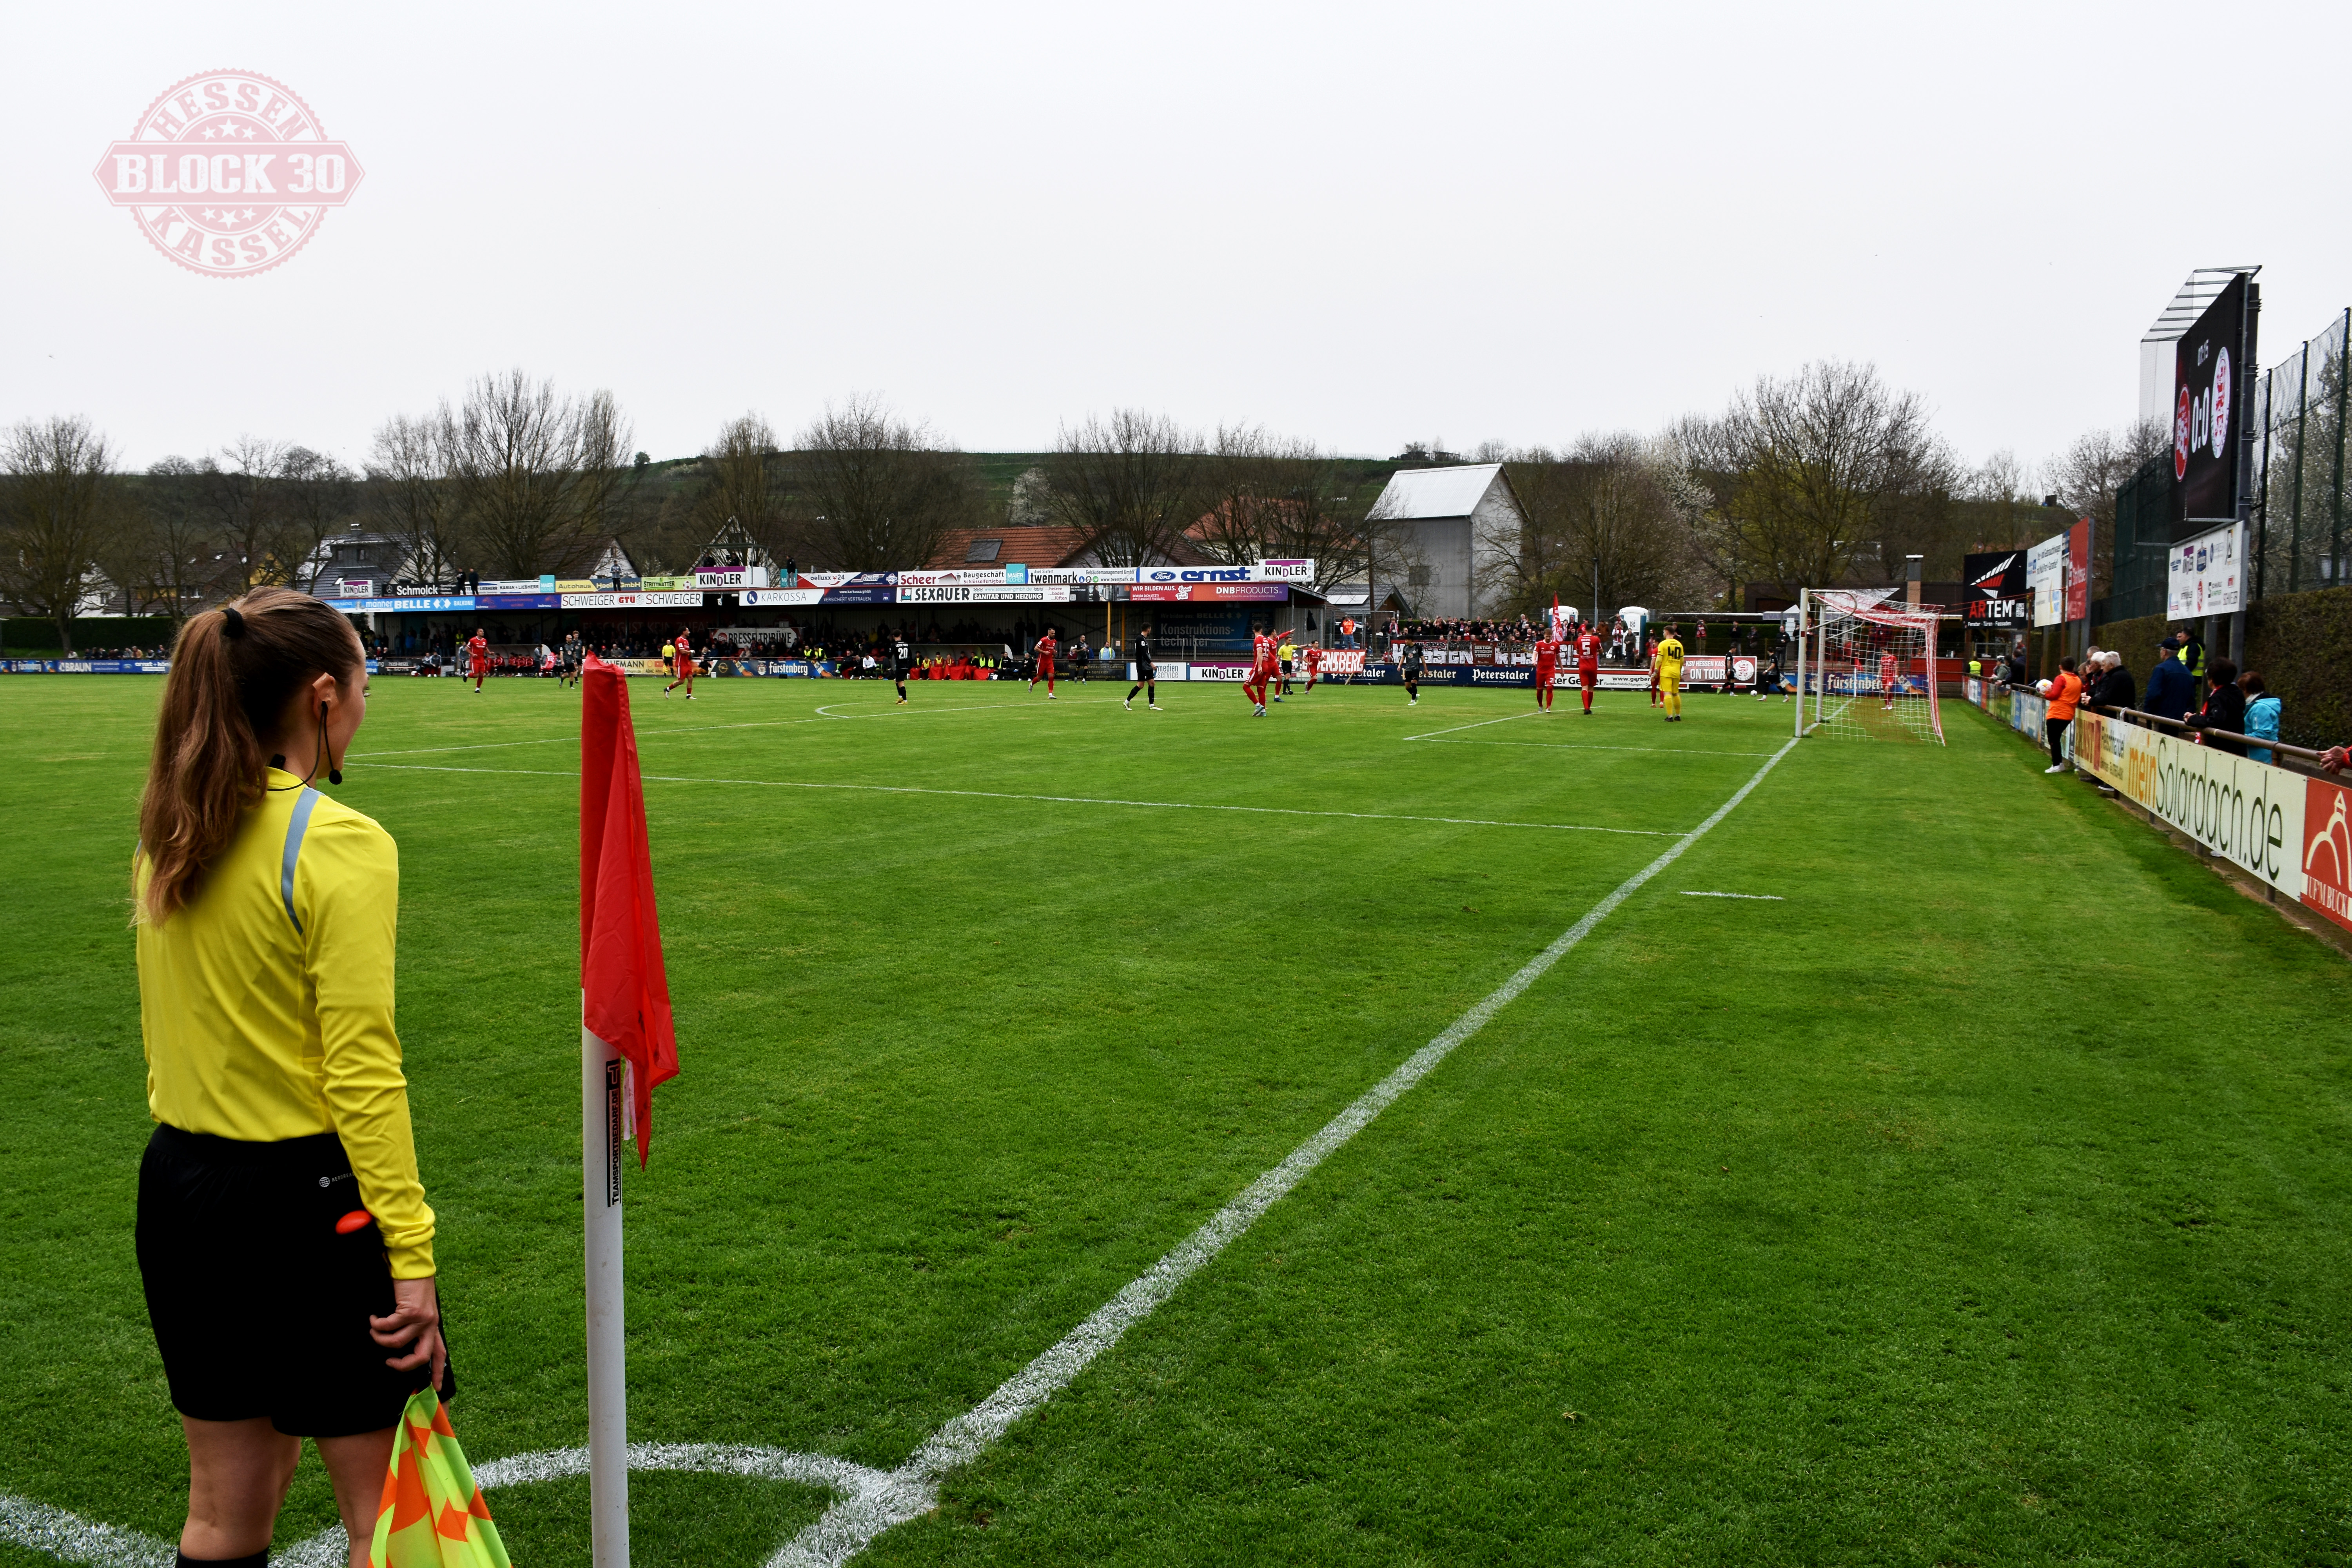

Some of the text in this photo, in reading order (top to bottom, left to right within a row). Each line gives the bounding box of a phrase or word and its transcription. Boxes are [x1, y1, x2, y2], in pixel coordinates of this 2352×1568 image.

[2192, 387, 2209, 453] 0:0
[1181, 567, 1250, 581] ernst
[1265, 566, 1307, 577] KINDLER
[700, 574, 741, 586] KINDLER
[900, 575, 937, 584] Scheer
[1031, 572, 1078, 583] twenmark
[344, 586, 368, 594] KINDLER
[396, 584, 438, 595] Schmolck
[915, 588, 970, 601] SEXAUER
[562, 595, 615, 606] SCHWEIGER
[618, 594, 635, 603] GTÜ
[646, 593, 701, 604] SCHWEIGER
[761, 592, 806, 602] KARKOSSA
[394, 600, 430, 609] BELLE
[1969, 600, 2012, 618] ARTEM
[1161, 623, 1234, 635] Konstruktions-
[1160, 635, 1209, 646] techniker
[898, 648, 908, 659] 20
[1582, 642, 1590, 655] 5
[1668, 646, 1681, 660] 40
[65, 662, 92, 671] BRAUN
[1202, 669, 1243, 680] KINDLER
[1472, 669, 1529, 681] Peterstaler
[1690, 669, 1726, 679] ON TOUR
[2327, 885, 2349, 918] BUCK
